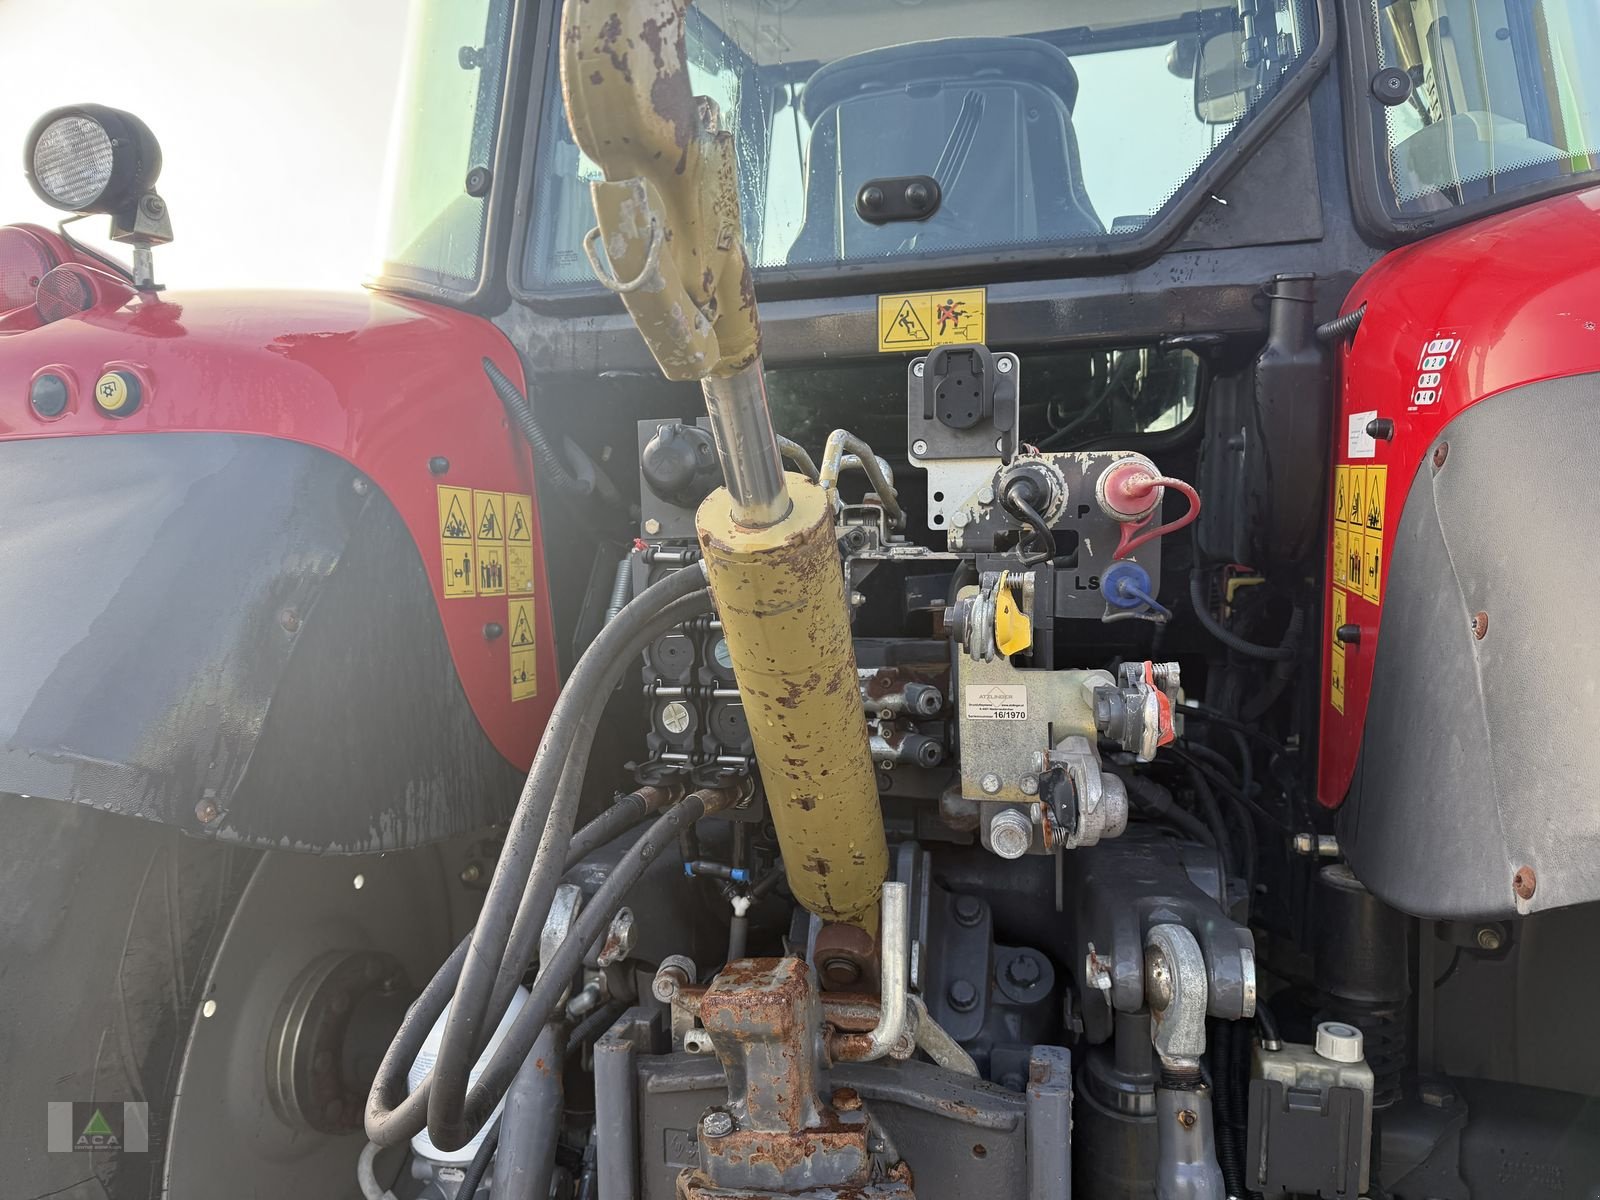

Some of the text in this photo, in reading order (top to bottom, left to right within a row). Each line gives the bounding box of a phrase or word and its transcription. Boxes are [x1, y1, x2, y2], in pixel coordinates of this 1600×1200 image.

[1431, 358, 1437, 368] 2
[1426, 375, 1432, 385] 3
[1078, 505, 1090, 519] P
[1075, 576, 1100, 590] LS
[994, 711, 1026, 719] 16/1970
